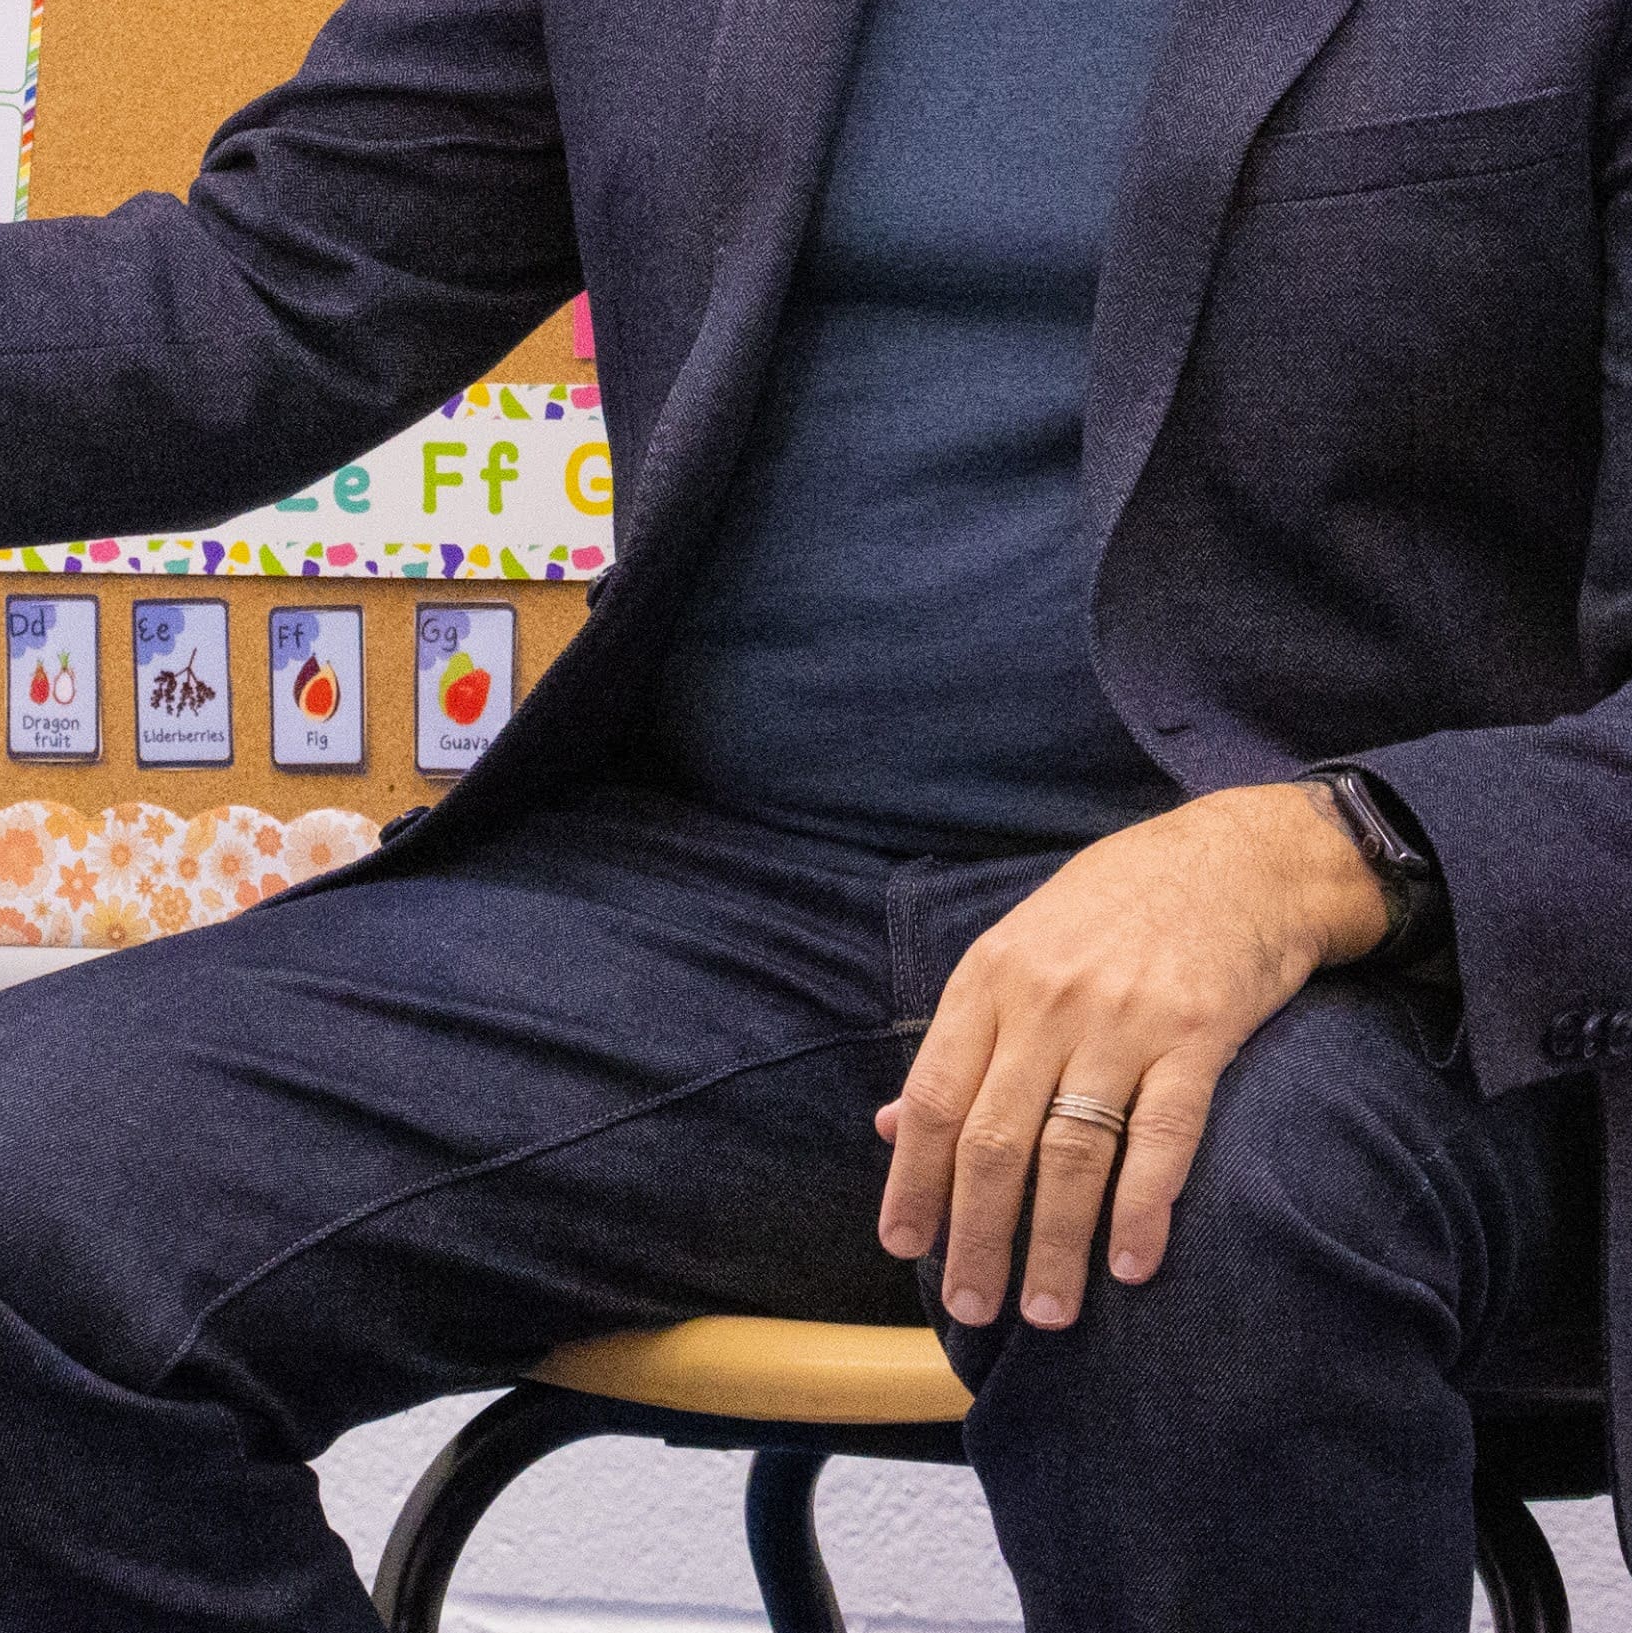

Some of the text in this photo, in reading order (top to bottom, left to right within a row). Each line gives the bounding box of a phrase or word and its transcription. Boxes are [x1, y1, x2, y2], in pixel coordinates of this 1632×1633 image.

[23, 715, 80, 734] Dragon
[34, 732, 72, 748] fruit
[144, 730, 225, 744] Elderberries
[306, 731, 329, 750] Fig
[440, 734, 489, 752] Guava
